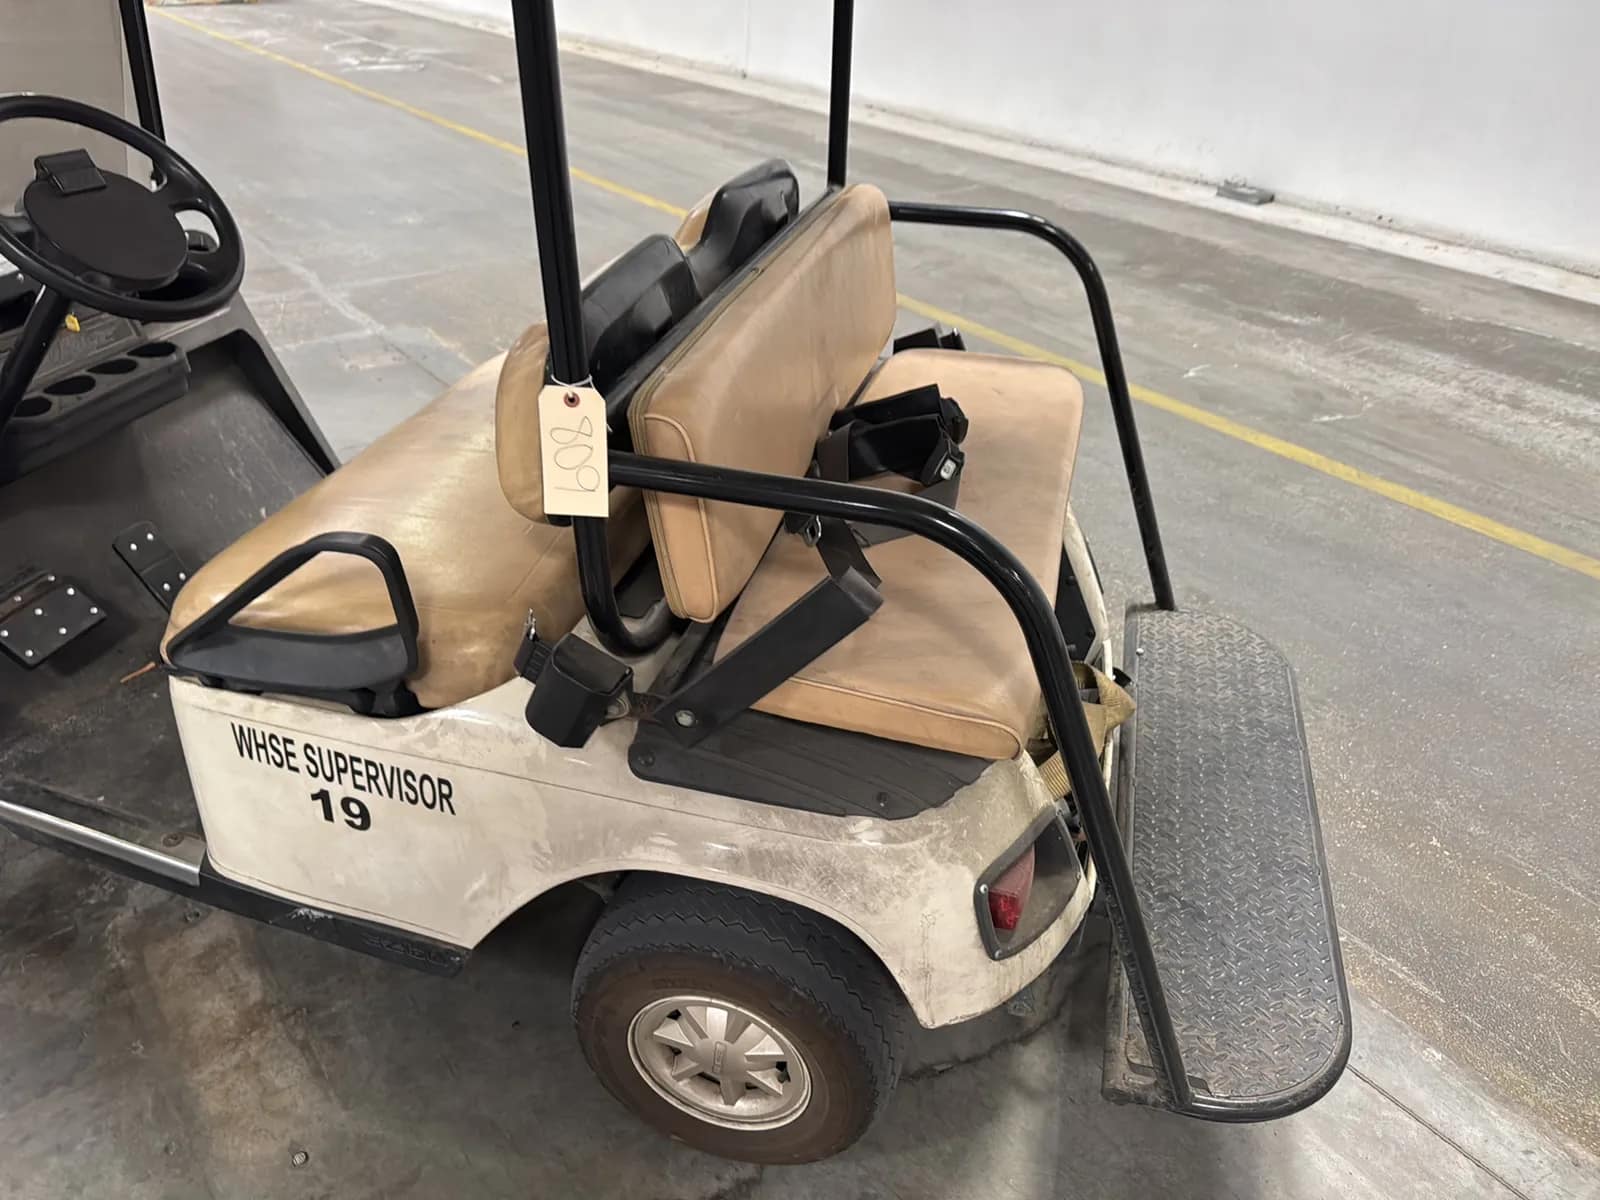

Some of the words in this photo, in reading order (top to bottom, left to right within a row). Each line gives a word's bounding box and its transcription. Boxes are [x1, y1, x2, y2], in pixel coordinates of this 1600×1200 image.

[231, 722, 299, 773] WHSE
[303, 743, 456, 815] SUPERVISOR
[311, 788, 371, 831] 19
